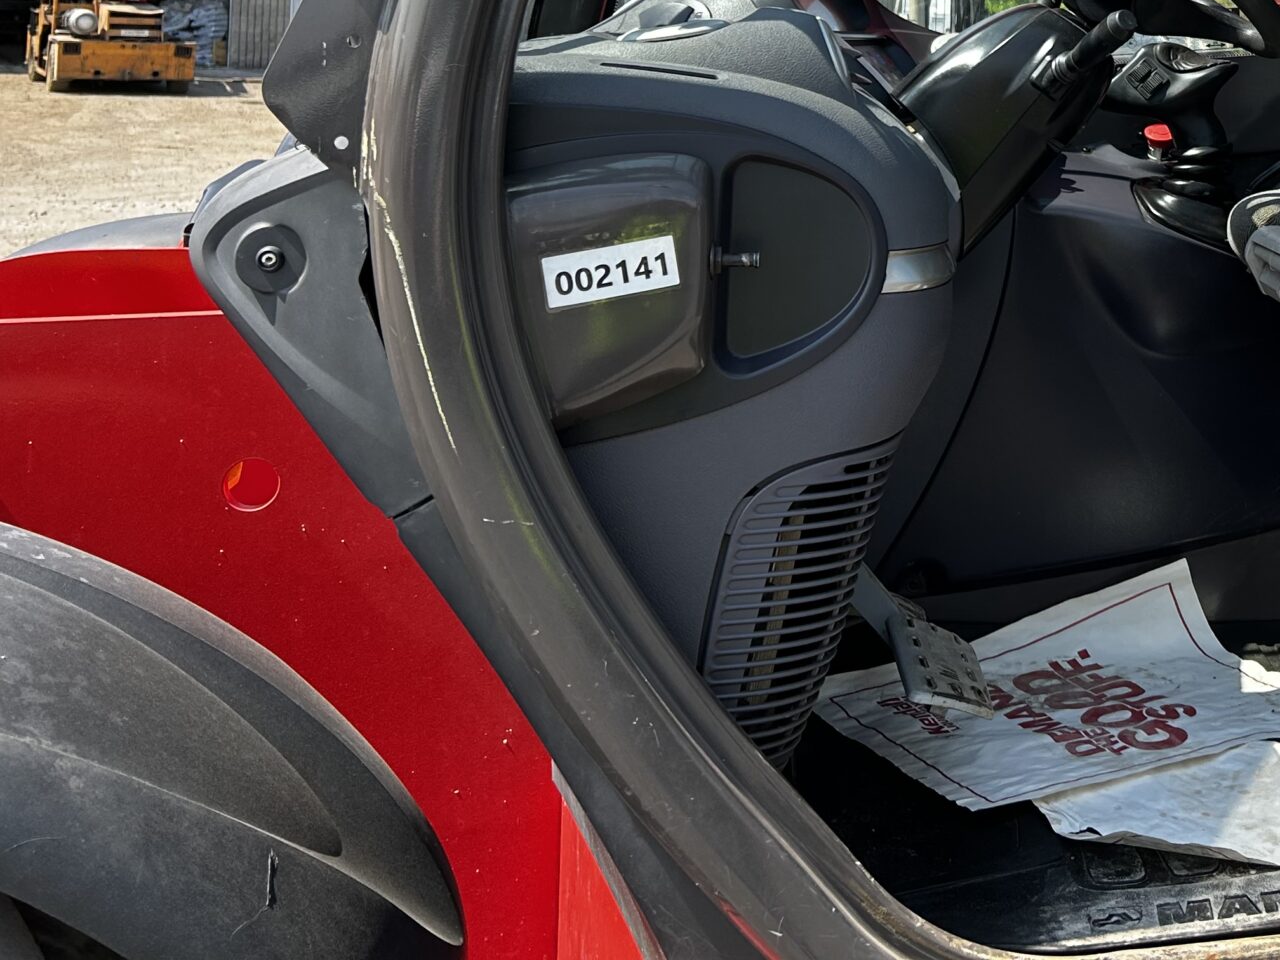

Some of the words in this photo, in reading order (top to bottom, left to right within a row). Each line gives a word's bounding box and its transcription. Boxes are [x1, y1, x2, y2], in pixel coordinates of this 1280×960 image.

[555, 252, 669, 296] 002141
[986, 683, 1107, 758] DEMAN
[1012, 670, 1188, 751] GOOD
